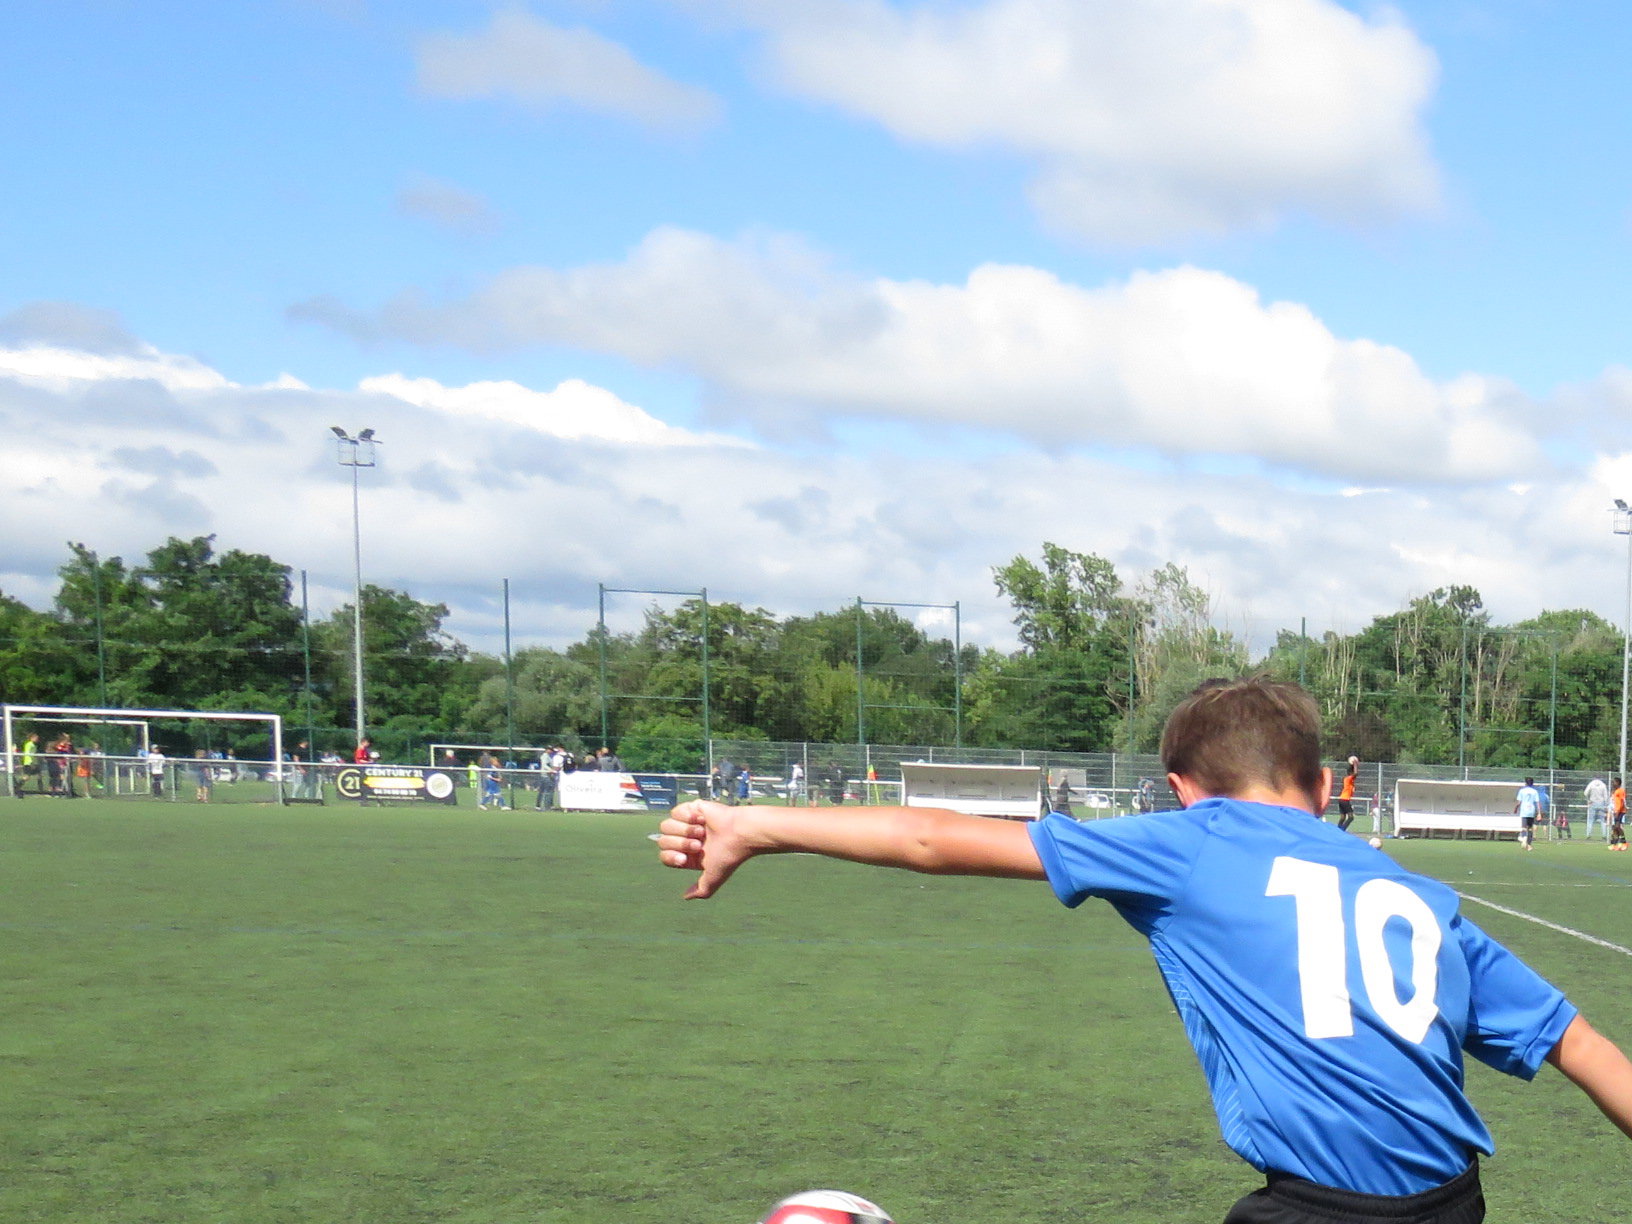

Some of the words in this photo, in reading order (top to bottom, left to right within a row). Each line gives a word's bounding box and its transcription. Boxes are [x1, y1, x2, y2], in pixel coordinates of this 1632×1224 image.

[364, 767, 412, 777] CENTURY
[344, 776, 360, 790] 21
[1264, 856, 1442, 1044] 10
